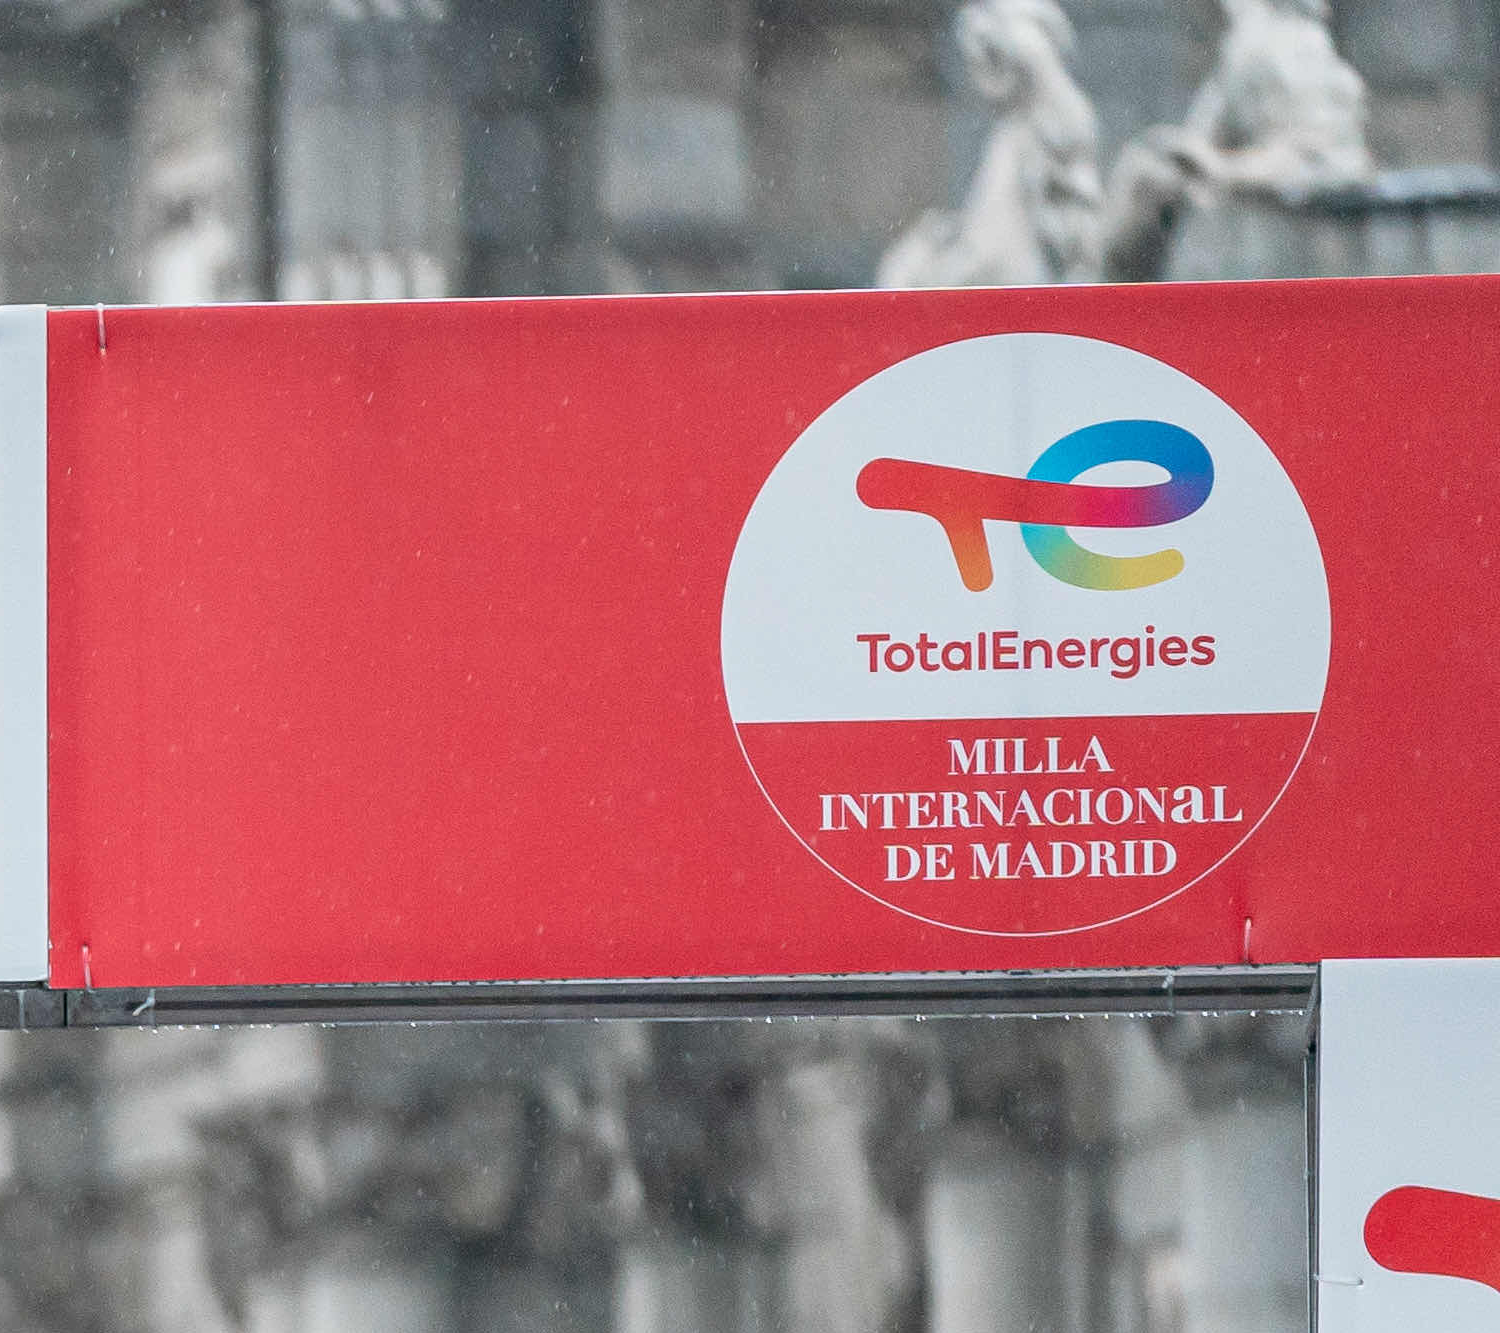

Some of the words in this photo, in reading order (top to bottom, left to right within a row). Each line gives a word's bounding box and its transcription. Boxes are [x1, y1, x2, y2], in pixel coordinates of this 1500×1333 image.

[857, 625, 1215, 679] TotalEnergies
[948, 736, 1114, 775] MILLA
[885, 844, 955, 881] DE
[970, 840, 1177, 879] MADRID
